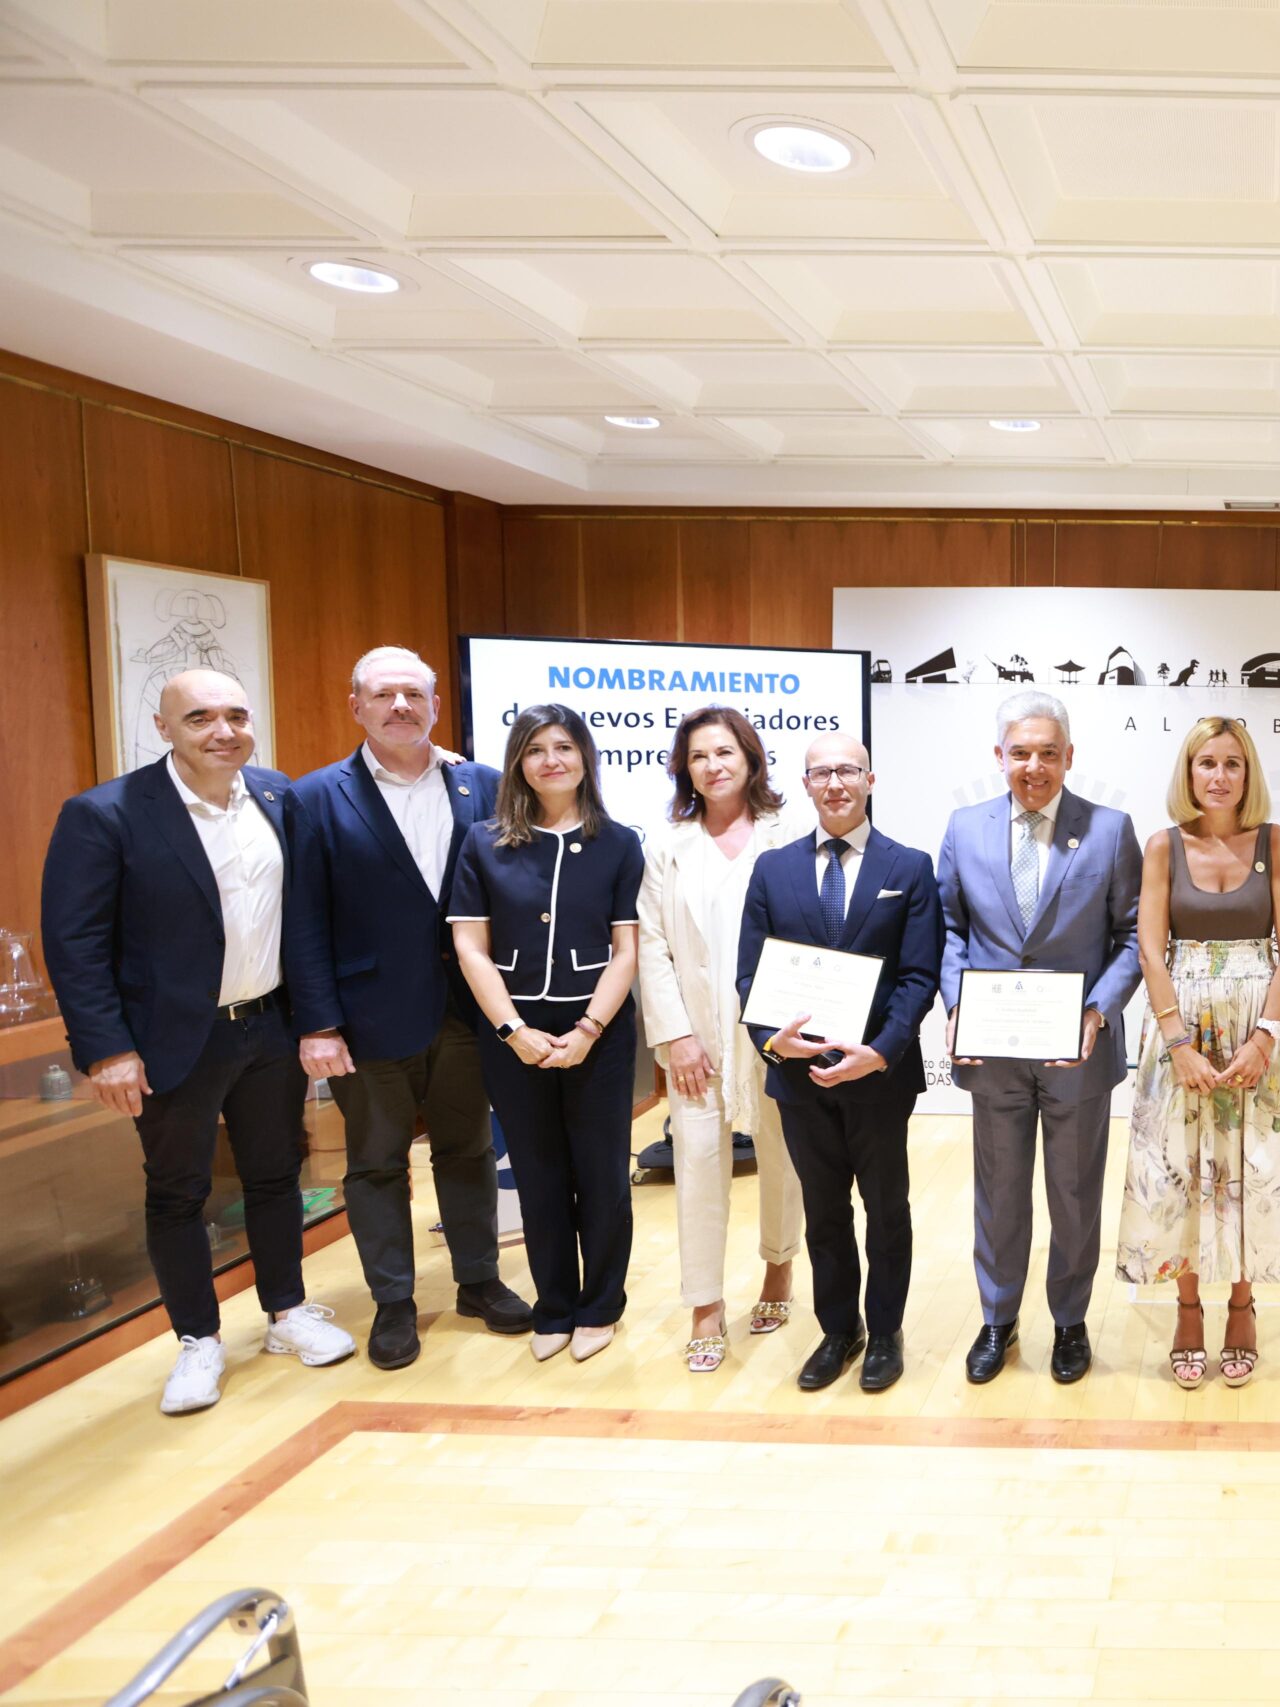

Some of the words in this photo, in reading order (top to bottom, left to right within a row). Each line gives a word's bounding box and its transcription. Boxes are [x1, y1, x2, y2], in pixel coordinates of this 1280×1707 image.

[548, 666, 801, 695] NOMBRAMIENTO
[581, 707, 655, 729] evos
[665, 707, 840, 731] Eadores
